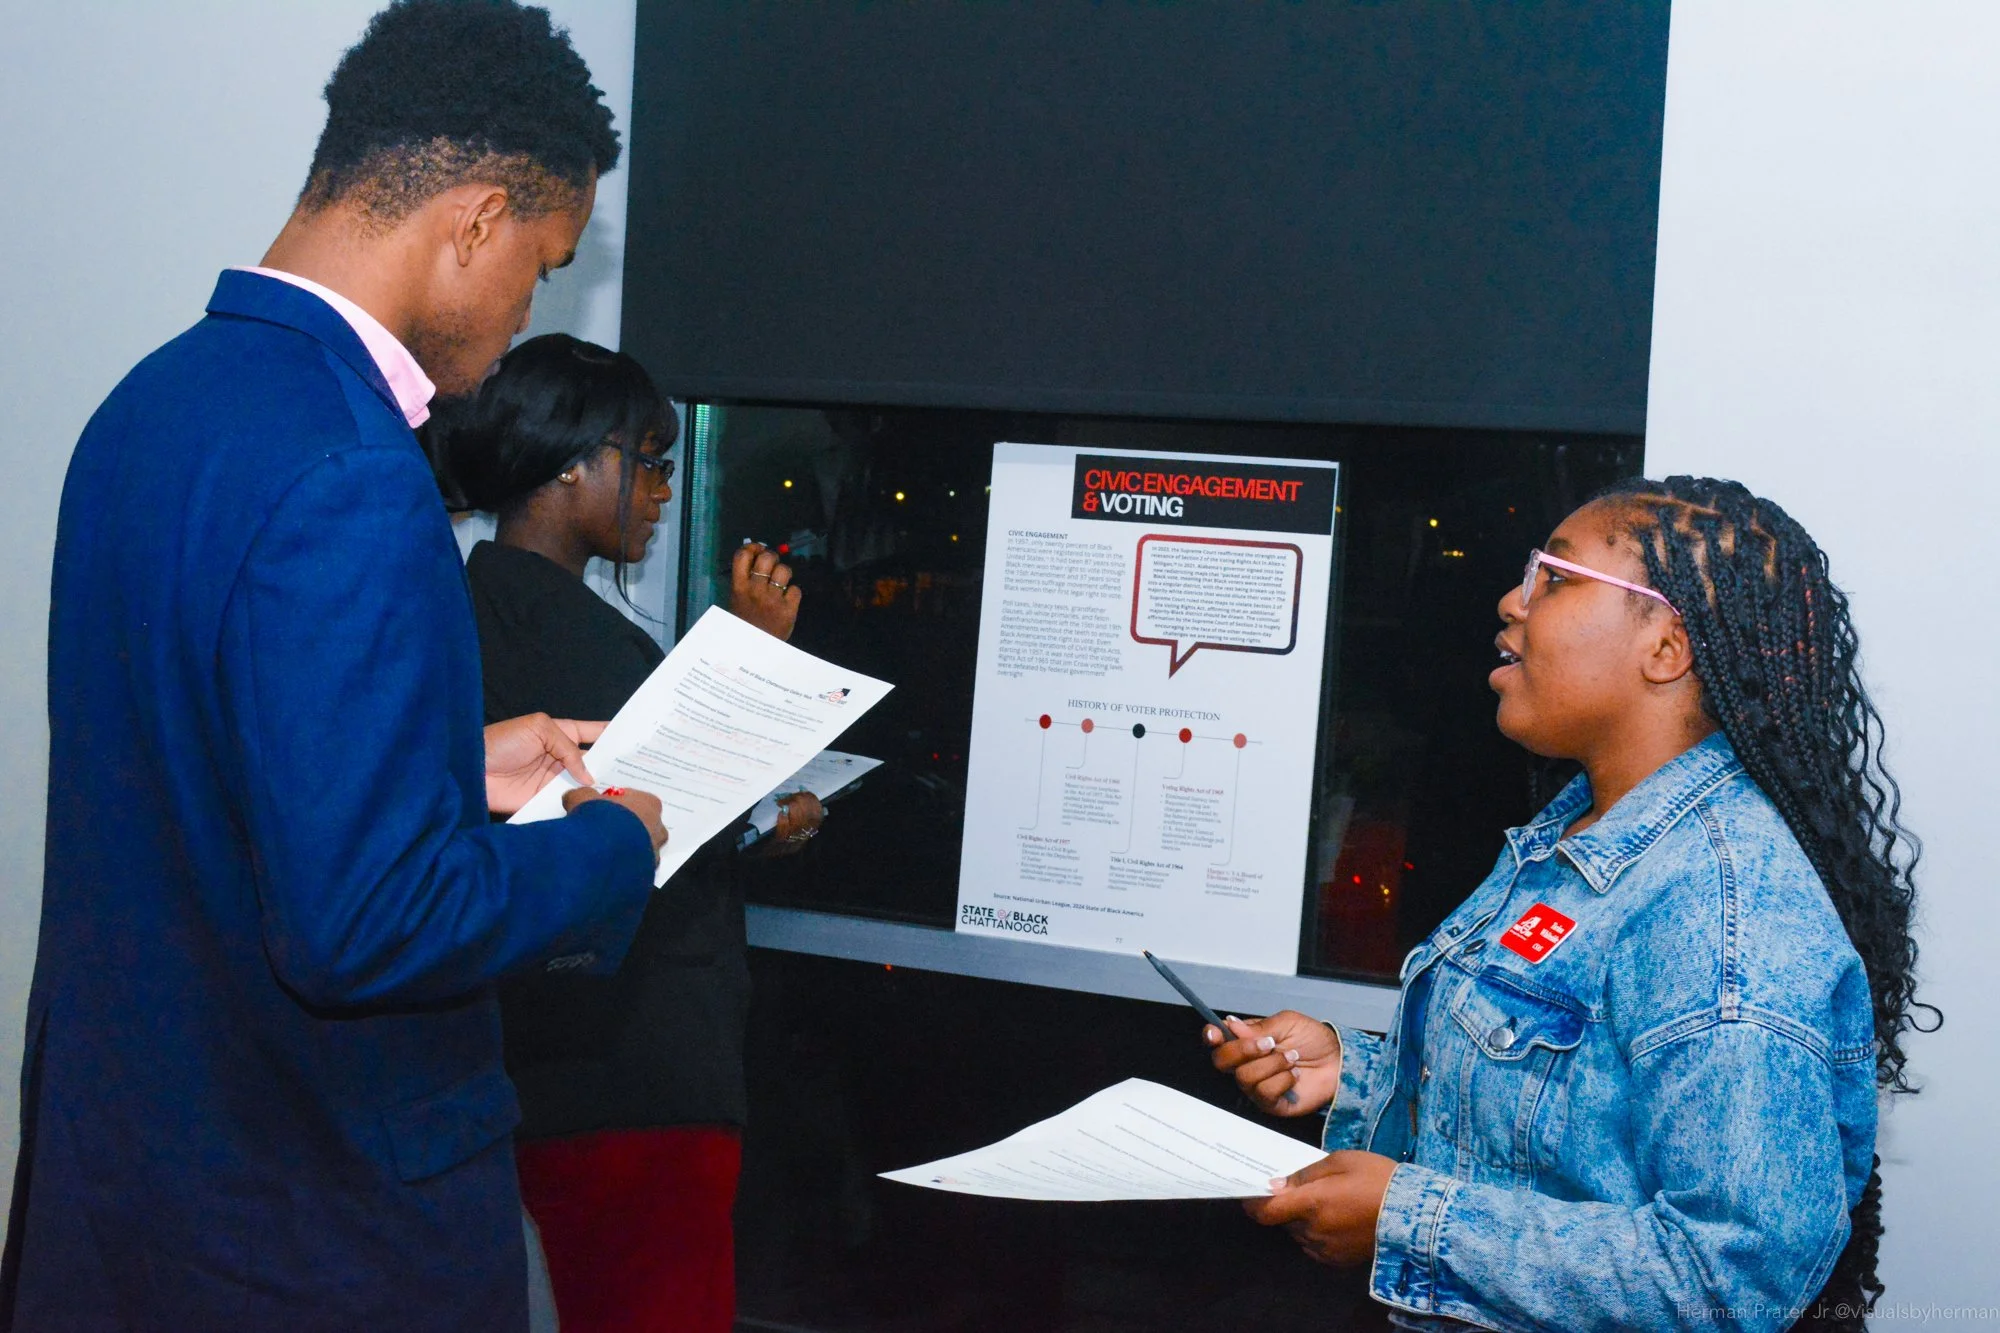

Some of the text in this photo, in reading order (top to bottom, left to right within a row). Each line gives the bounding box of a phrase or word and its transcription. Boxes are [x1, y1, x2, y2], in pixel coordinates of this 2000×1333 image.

[1084, 469, 1303, 501] CIVIC ENGAGEMENT
[1083, 492, 1184, 517] & VOTING
[1068, 699, 1220, 721] HISTORY OF VOTER PROTECTION
[961, 915, 1048, 936] CHATTANOOGA
[962, 904, 994, 918] STATE
[1013, 911, 1049, 925] BLACK
